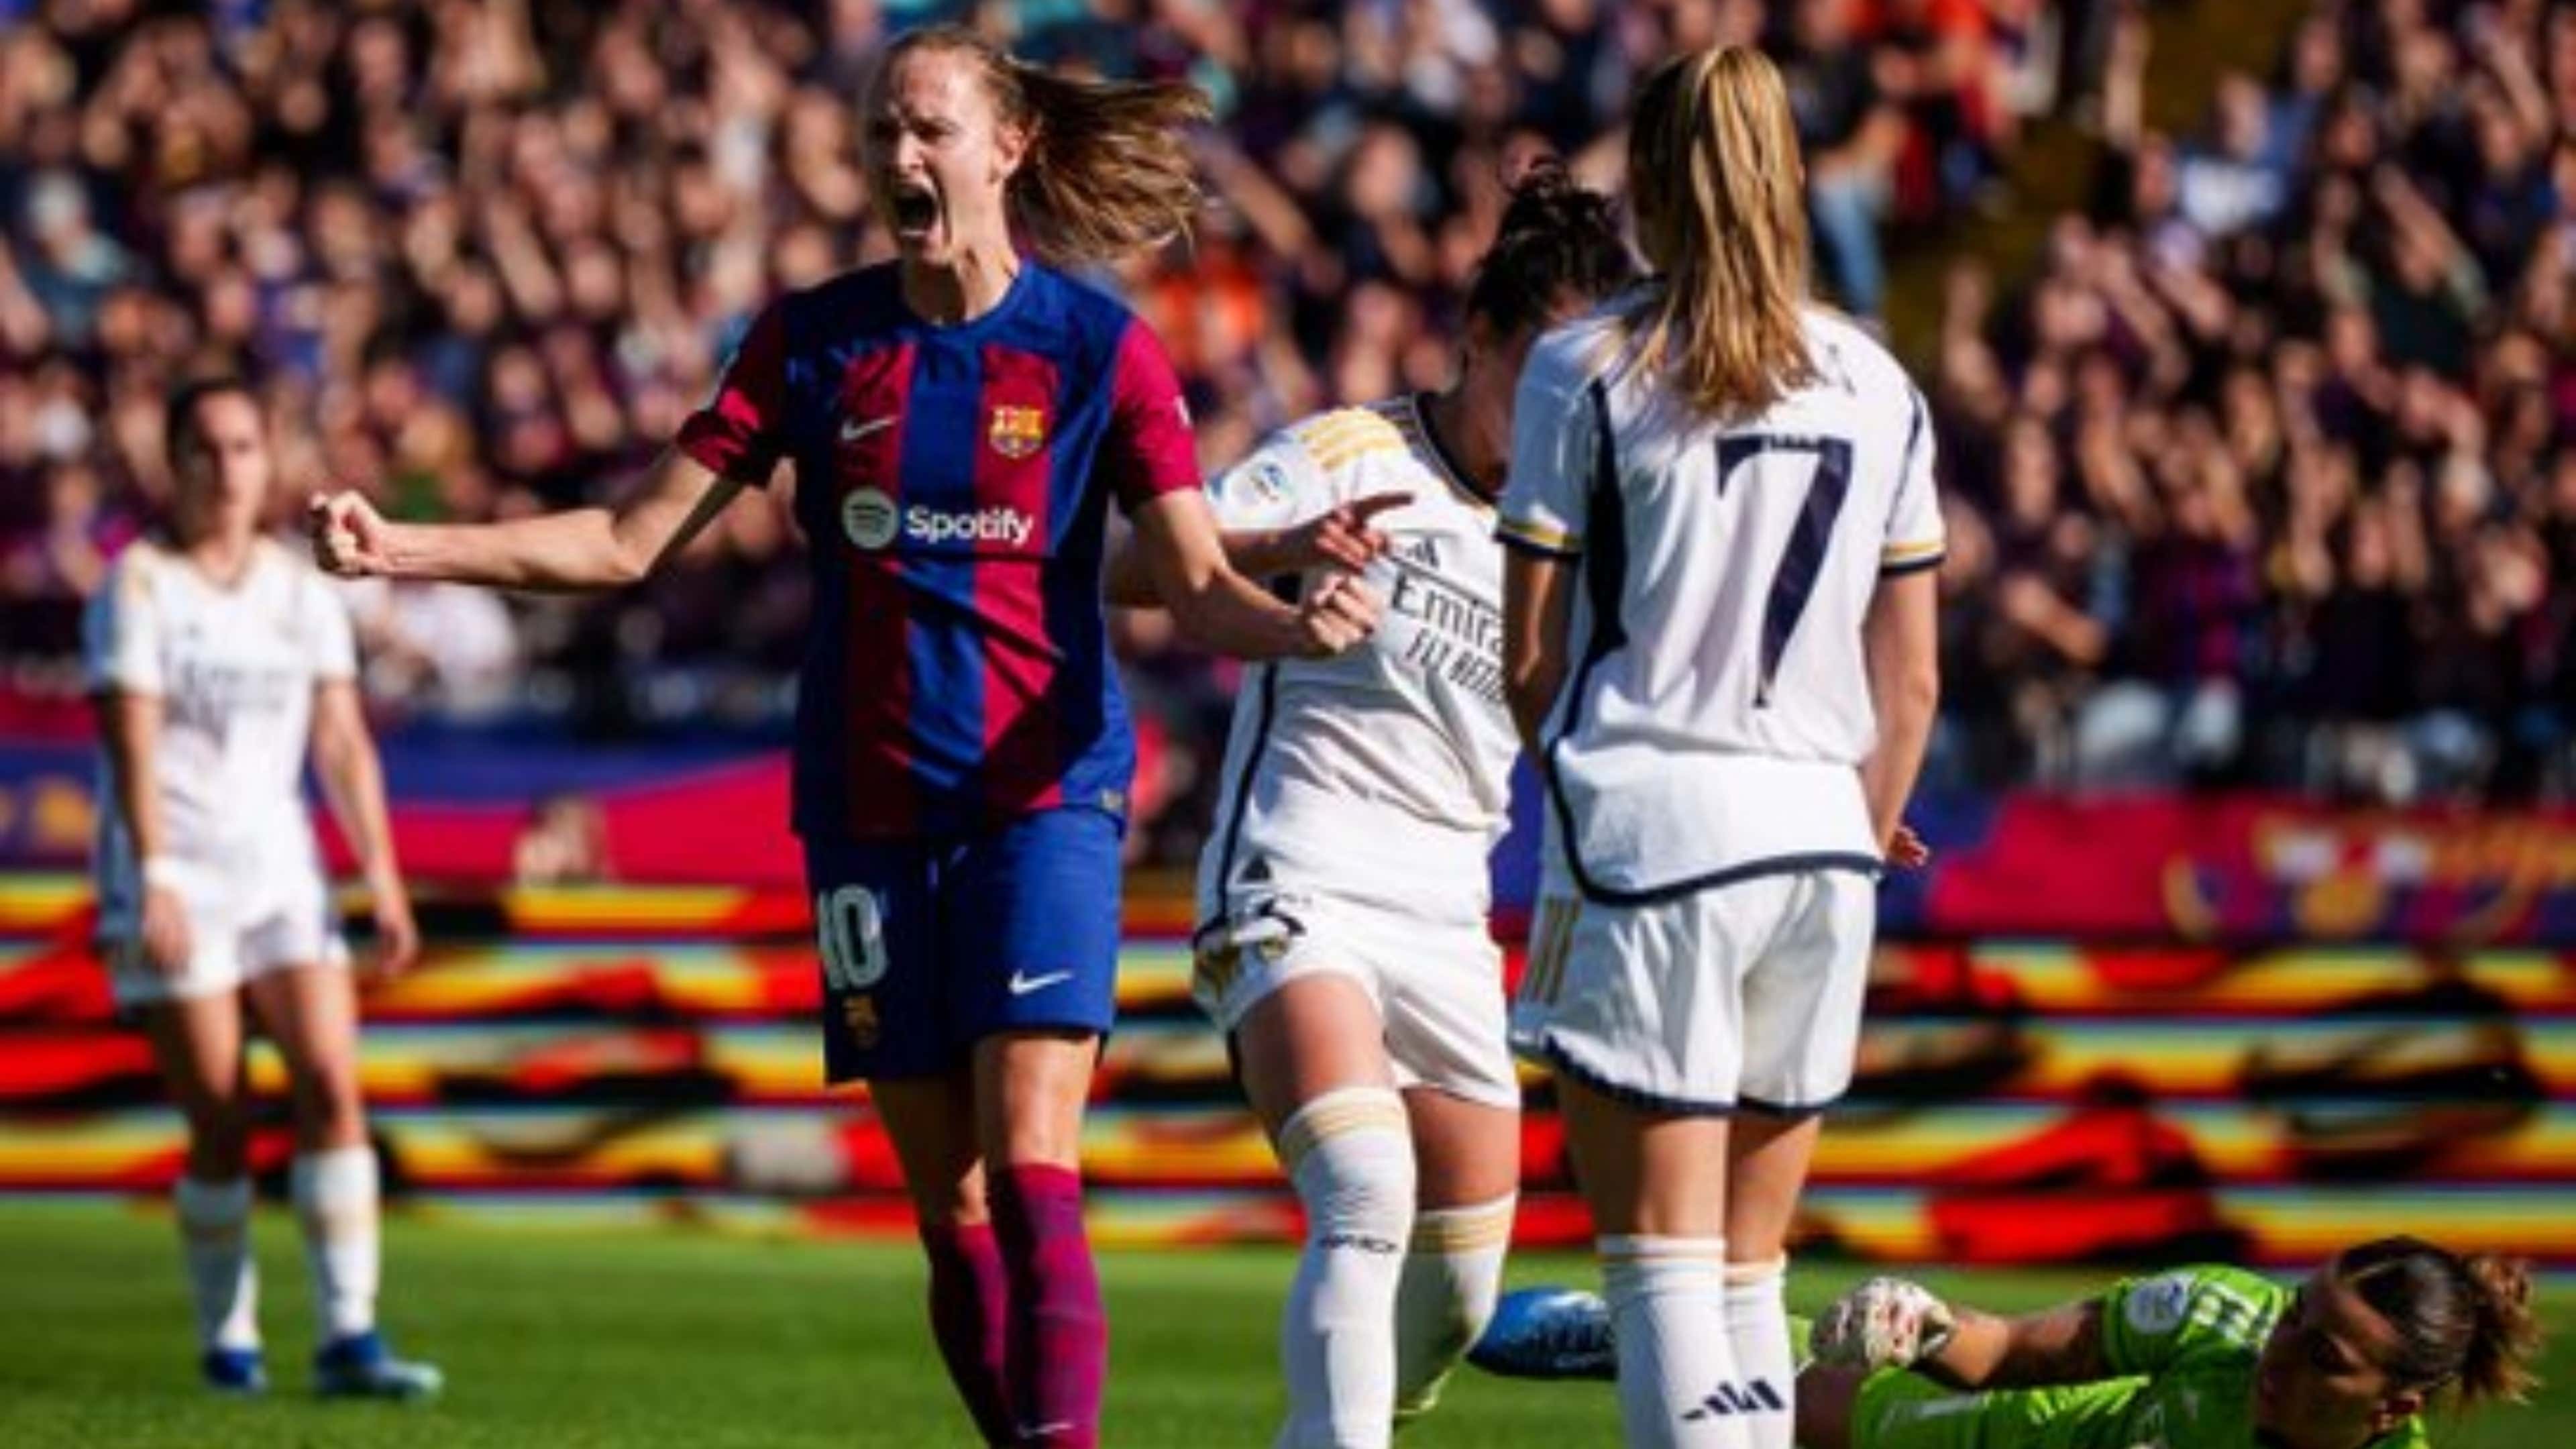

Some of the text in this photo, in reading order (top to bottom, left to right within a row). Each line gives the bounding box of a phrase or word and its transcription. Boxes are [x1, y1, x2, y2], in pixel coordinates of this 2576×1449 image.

[907, 504, 1034, 549] Spotify
[1714, 433, 1854, 709] 7
[818, 884, 890, 990] 10
